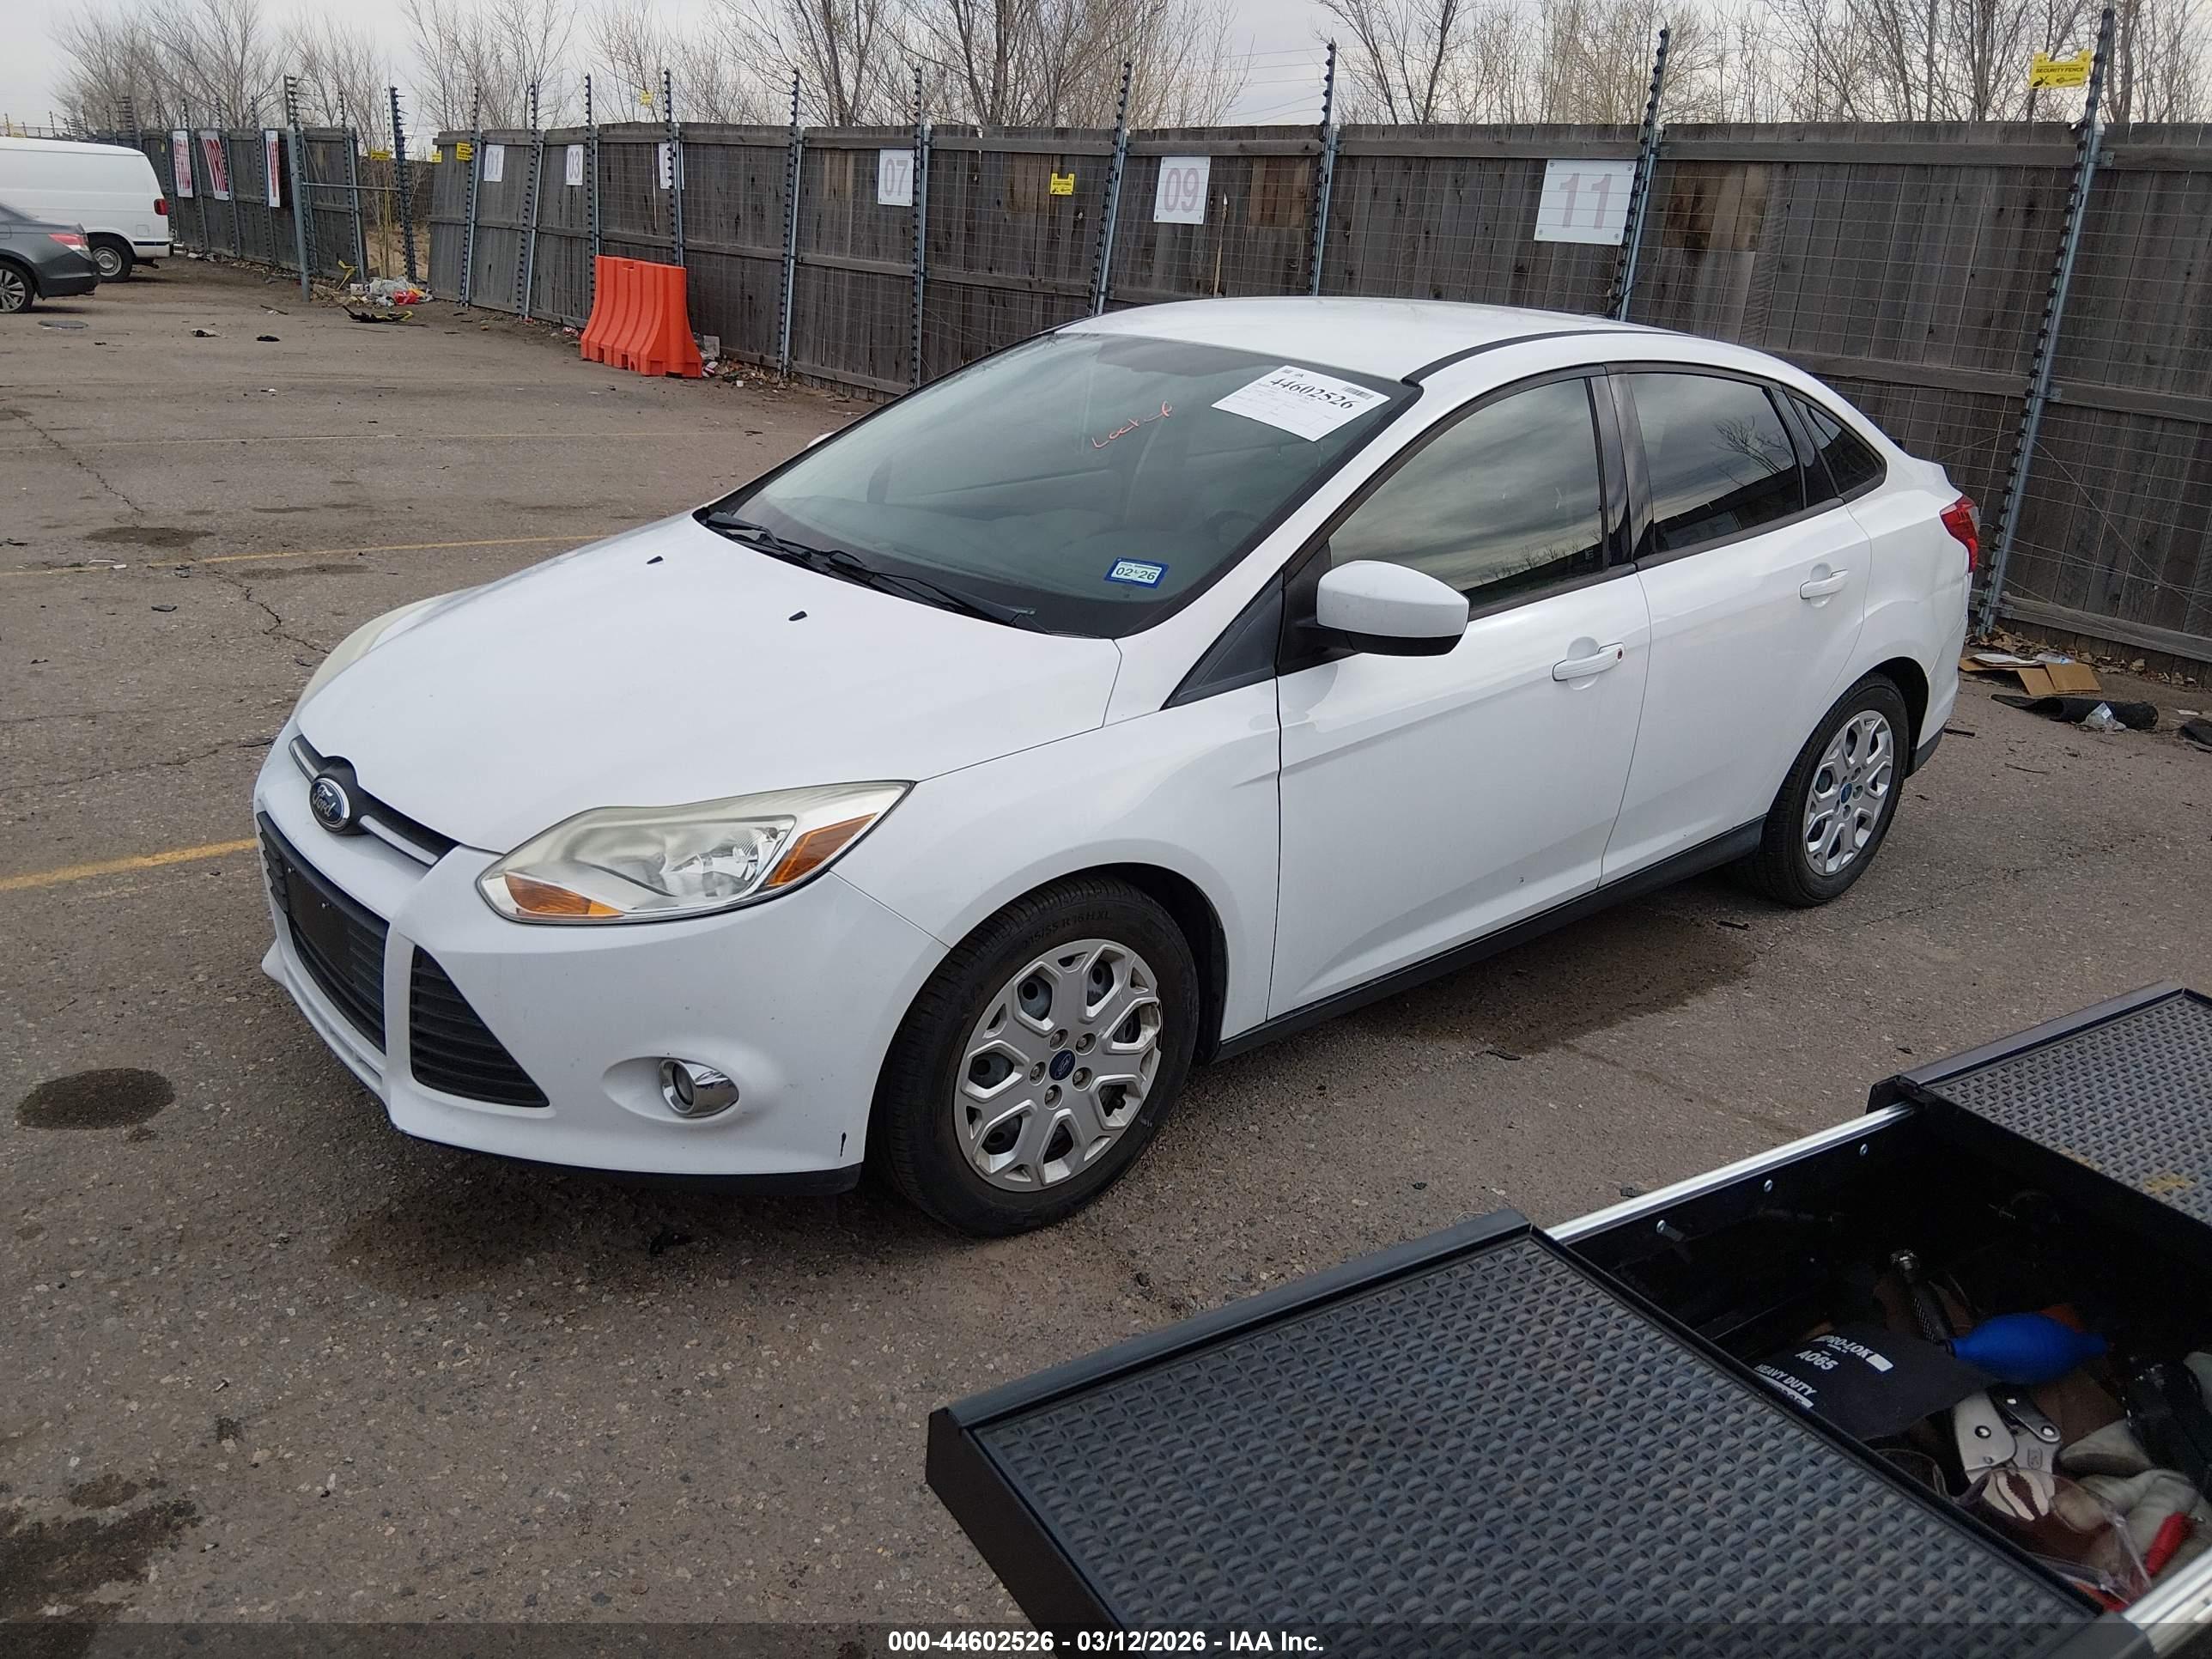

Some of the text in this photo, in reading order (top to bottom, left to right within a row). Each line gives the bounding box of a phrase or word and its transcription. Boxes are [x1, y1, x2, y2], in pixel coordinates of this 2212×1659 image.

[486, 149, 501, 176] 01
[568, 149, 581, 179] 03
[883, 158, 909, 197] 07
[1164, 167, 1200, 213] 09
[1559, 172, 1613, 230] 11
[1270, 377, 1361, 410] 44602526
[1115, 567, 1134, 577] 02
[1137, 570, 1158, 580] 26
[1753, 1364, 1789, 1381] HEAVY
[1782, 1376, 1818, 1397] DUTY
